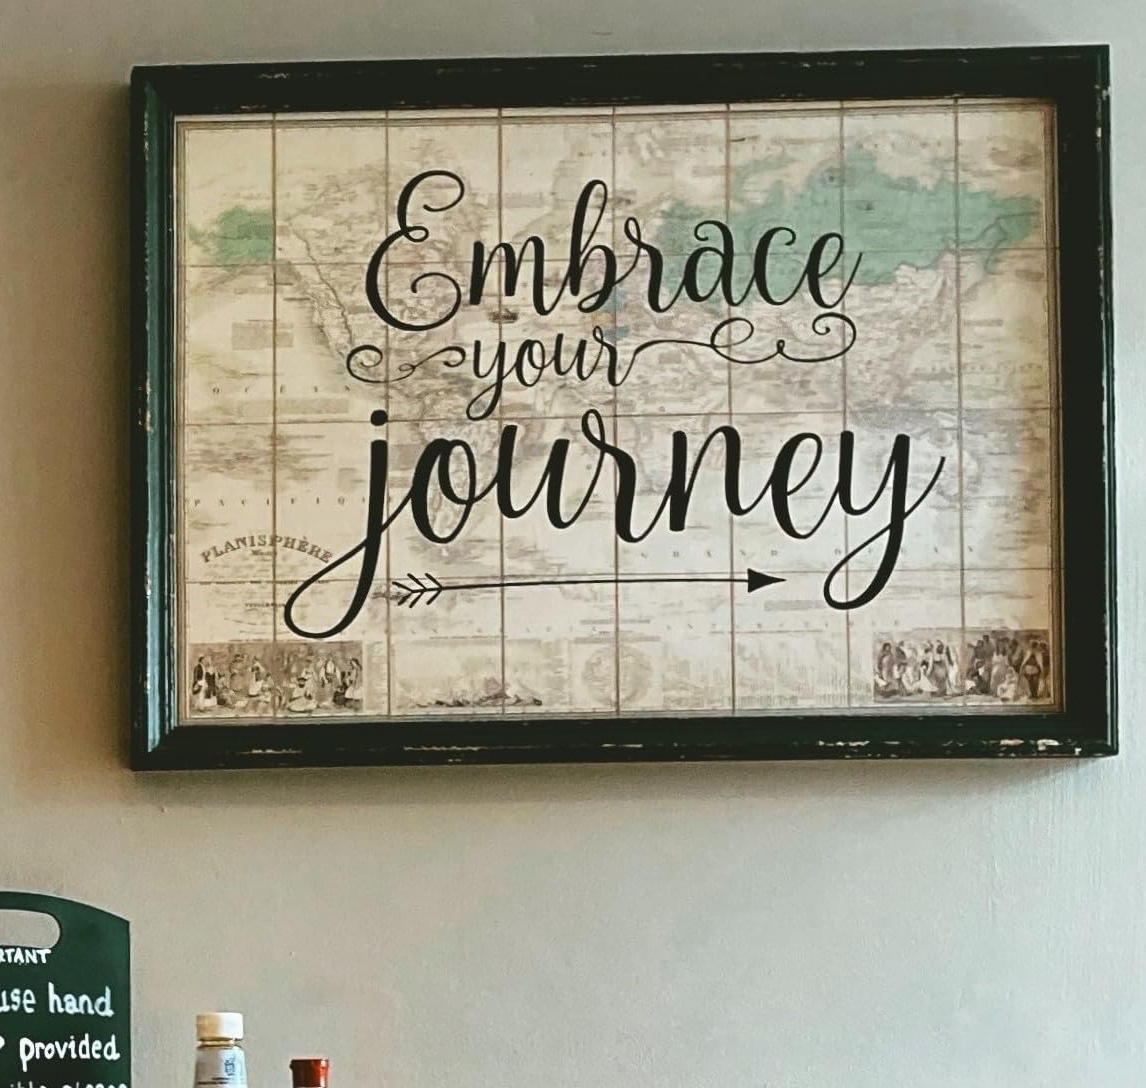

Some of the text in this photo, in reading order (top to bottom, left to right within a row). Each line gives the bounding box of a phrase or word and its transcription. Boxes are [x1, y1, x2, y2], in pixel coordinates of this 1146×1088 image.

[365, 169, 863, 332] Embrace
[466, 325, 638, 421] your
[283, 408, 946, 639] journey
[48, 982, 115, 1017] hand
[19, 1033, 121, 1072] provided
